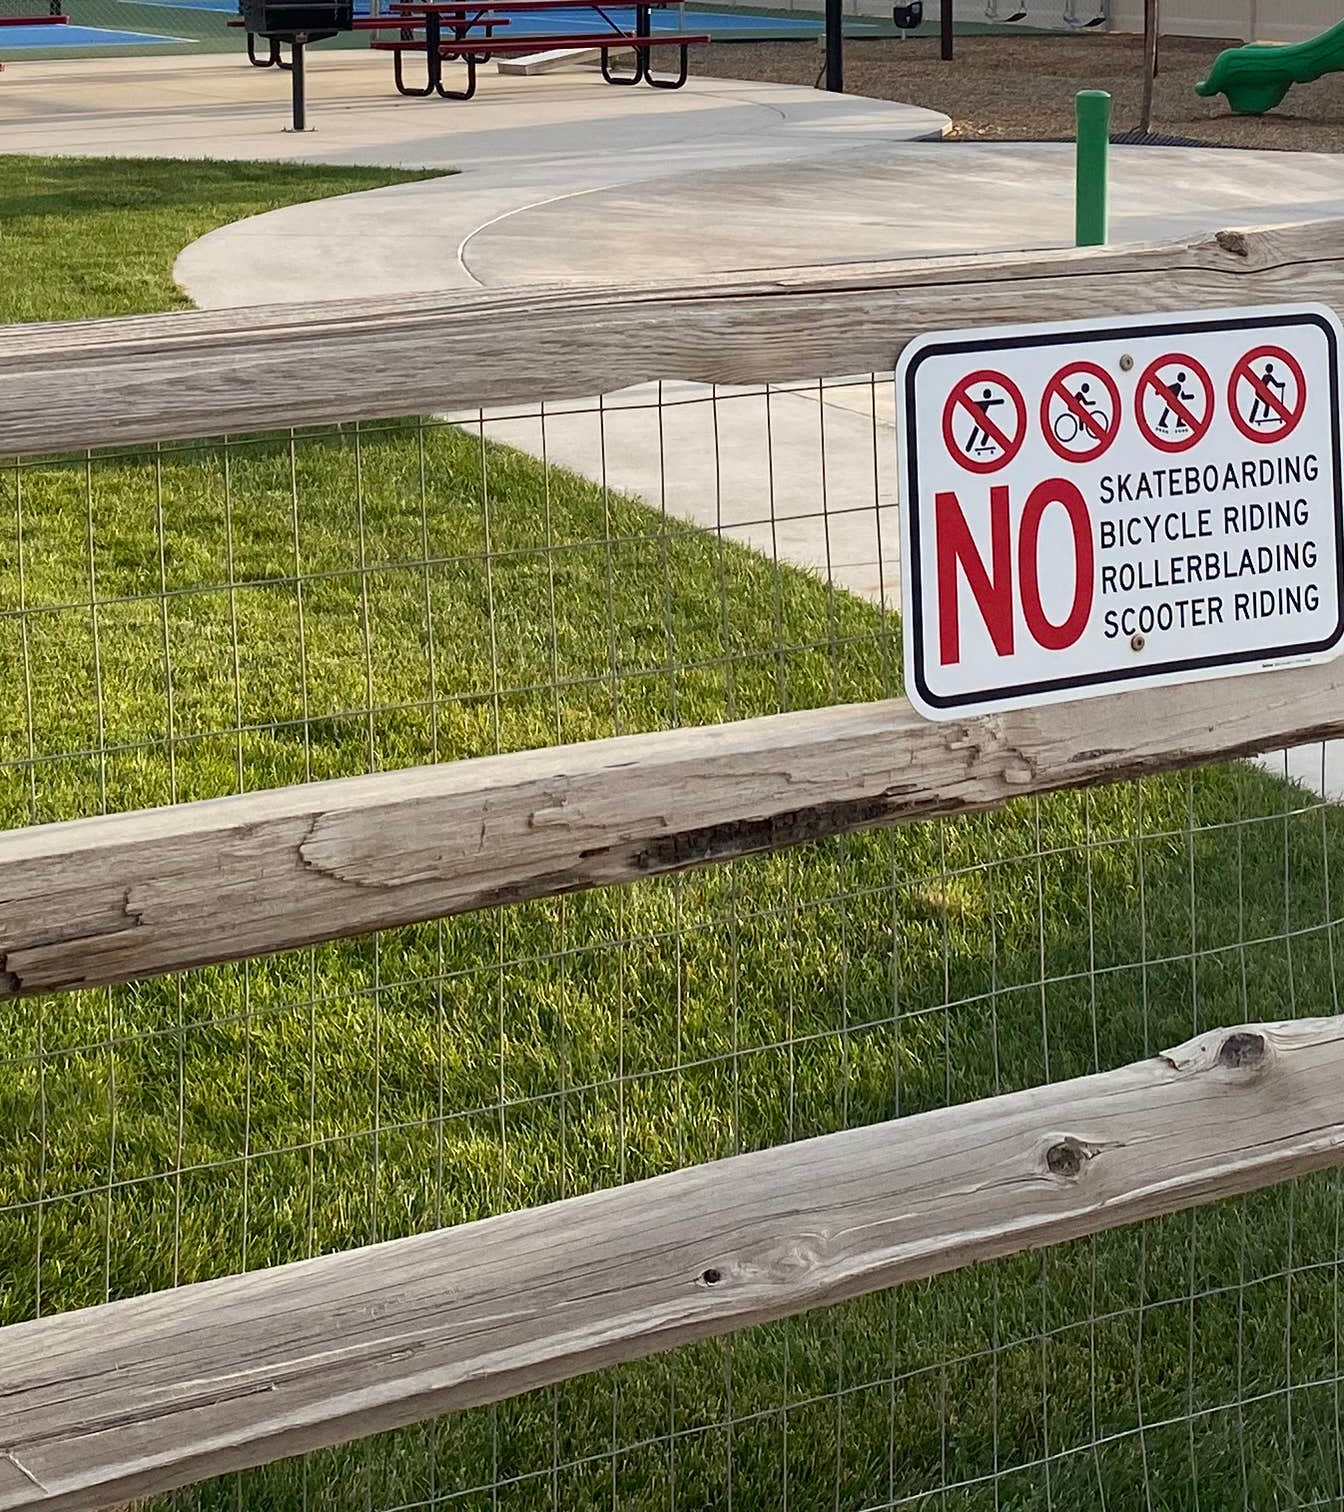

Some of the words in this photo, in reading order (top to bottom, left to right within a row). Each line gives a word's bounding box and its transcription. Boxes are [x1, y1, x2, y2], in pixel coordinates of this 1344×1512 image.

[1099, 454, 1319, 504] SKATEBOARDING
[1100, 509, 1212, 549] BICYCLE
[1223, 498, 1310, 535] RIDING
[934, 477, 1095, 666] NO
[1102, 541, 1317, 594] ROLLERBLADING
[1103, 596, 1224, 639] SCOOTER
[1234, 584, 1320, 620] RIDING
